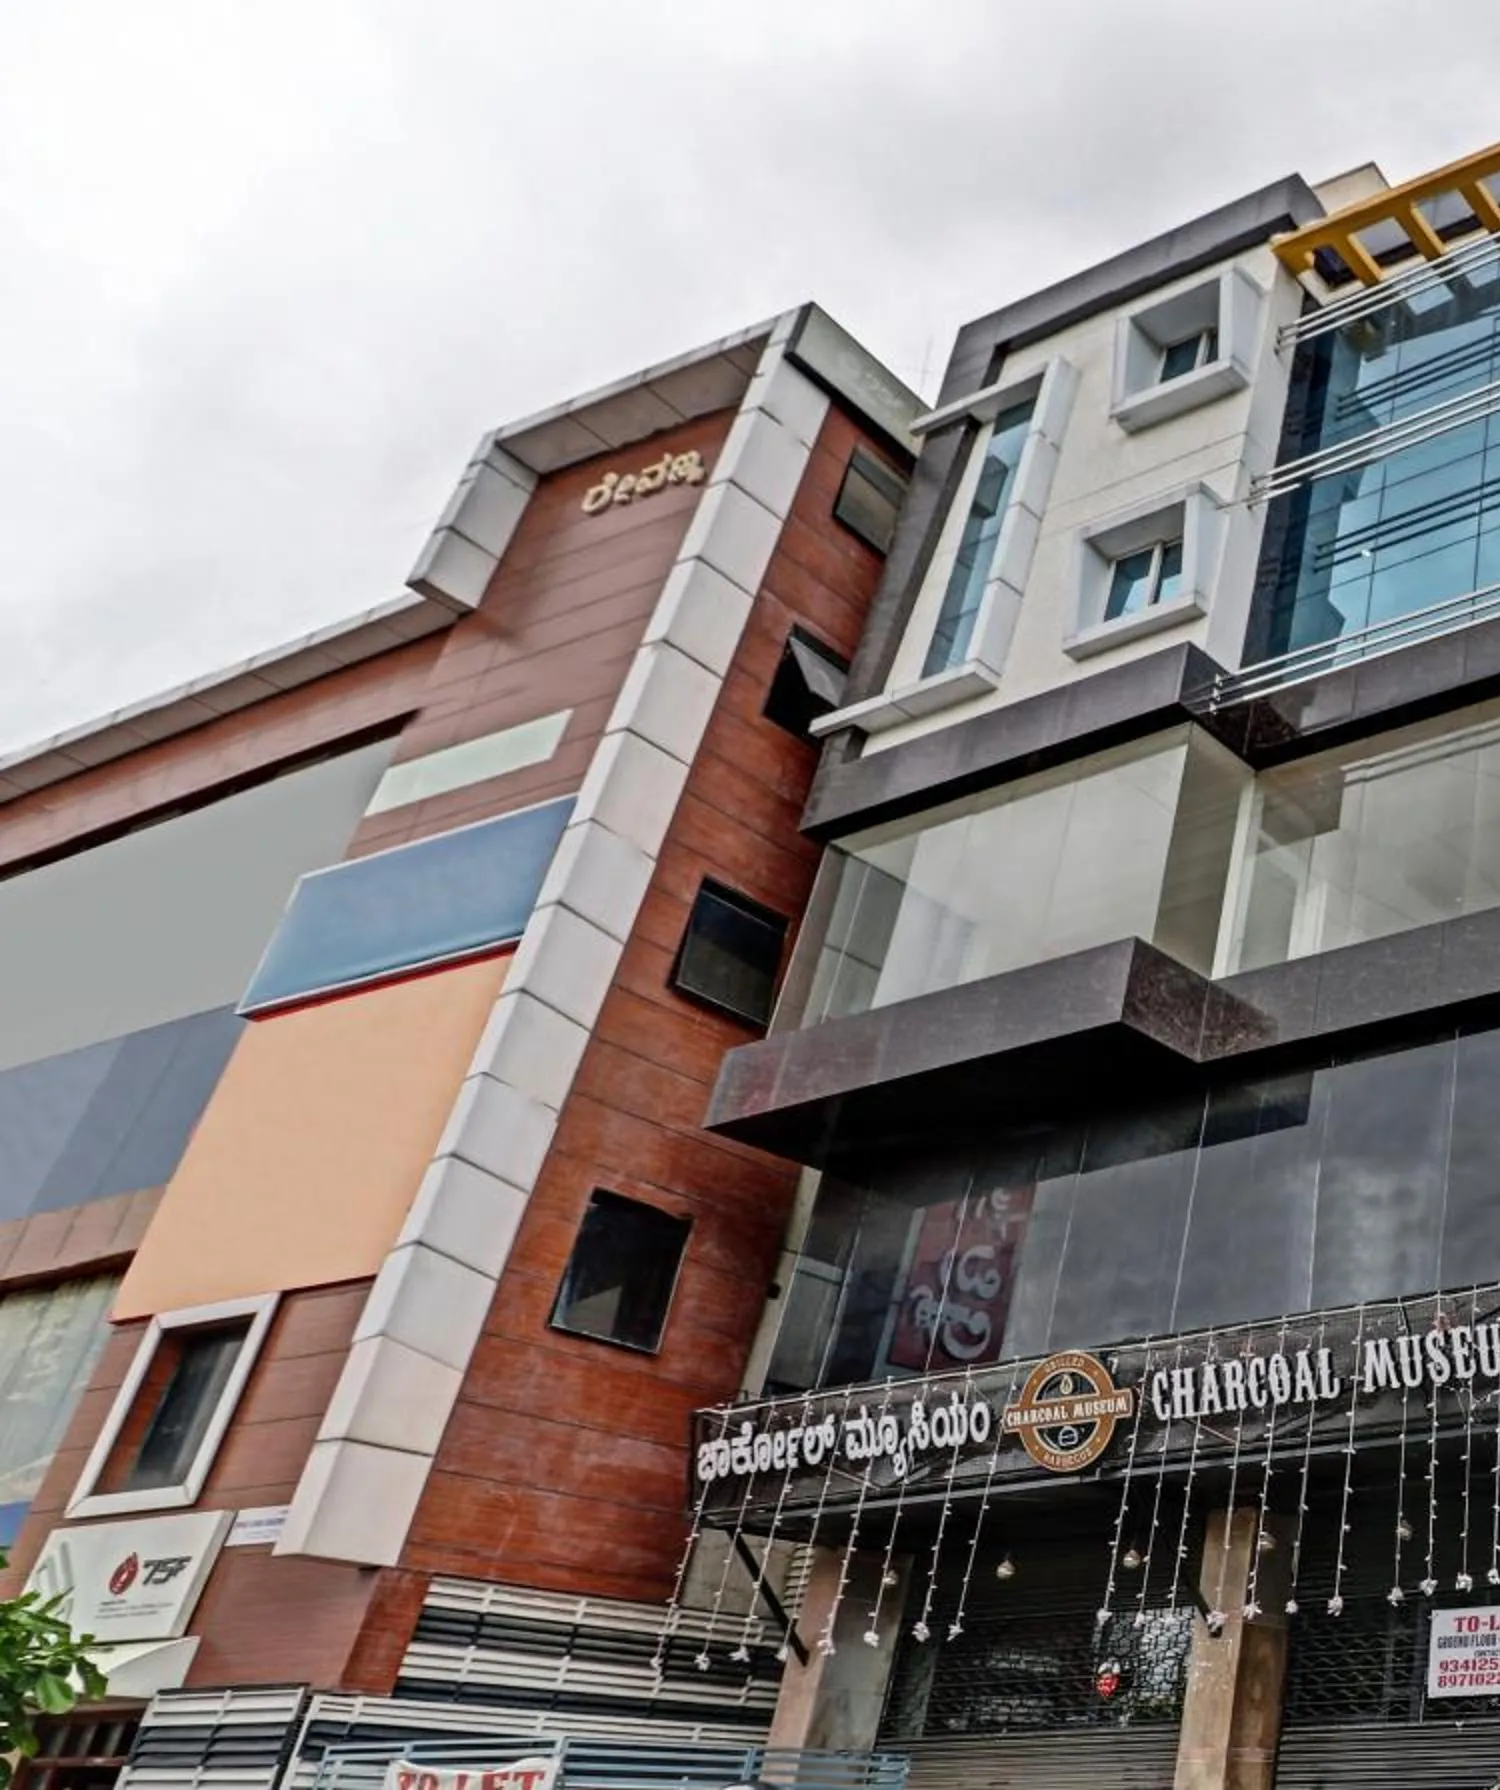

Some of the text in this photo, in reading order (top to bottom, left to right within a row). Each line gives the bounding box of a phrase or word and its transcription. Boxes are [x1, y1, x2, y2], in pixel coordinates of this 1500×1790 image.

[1152, 1346, 1341, 1420] CHARCOAL
[1007, 1395, 1128, 1427] CHARCOAL MUSEUM
[1437, 1633, 1470, 1649] GROUND
[1471, 1632, 1497, 1648] FLOOR
